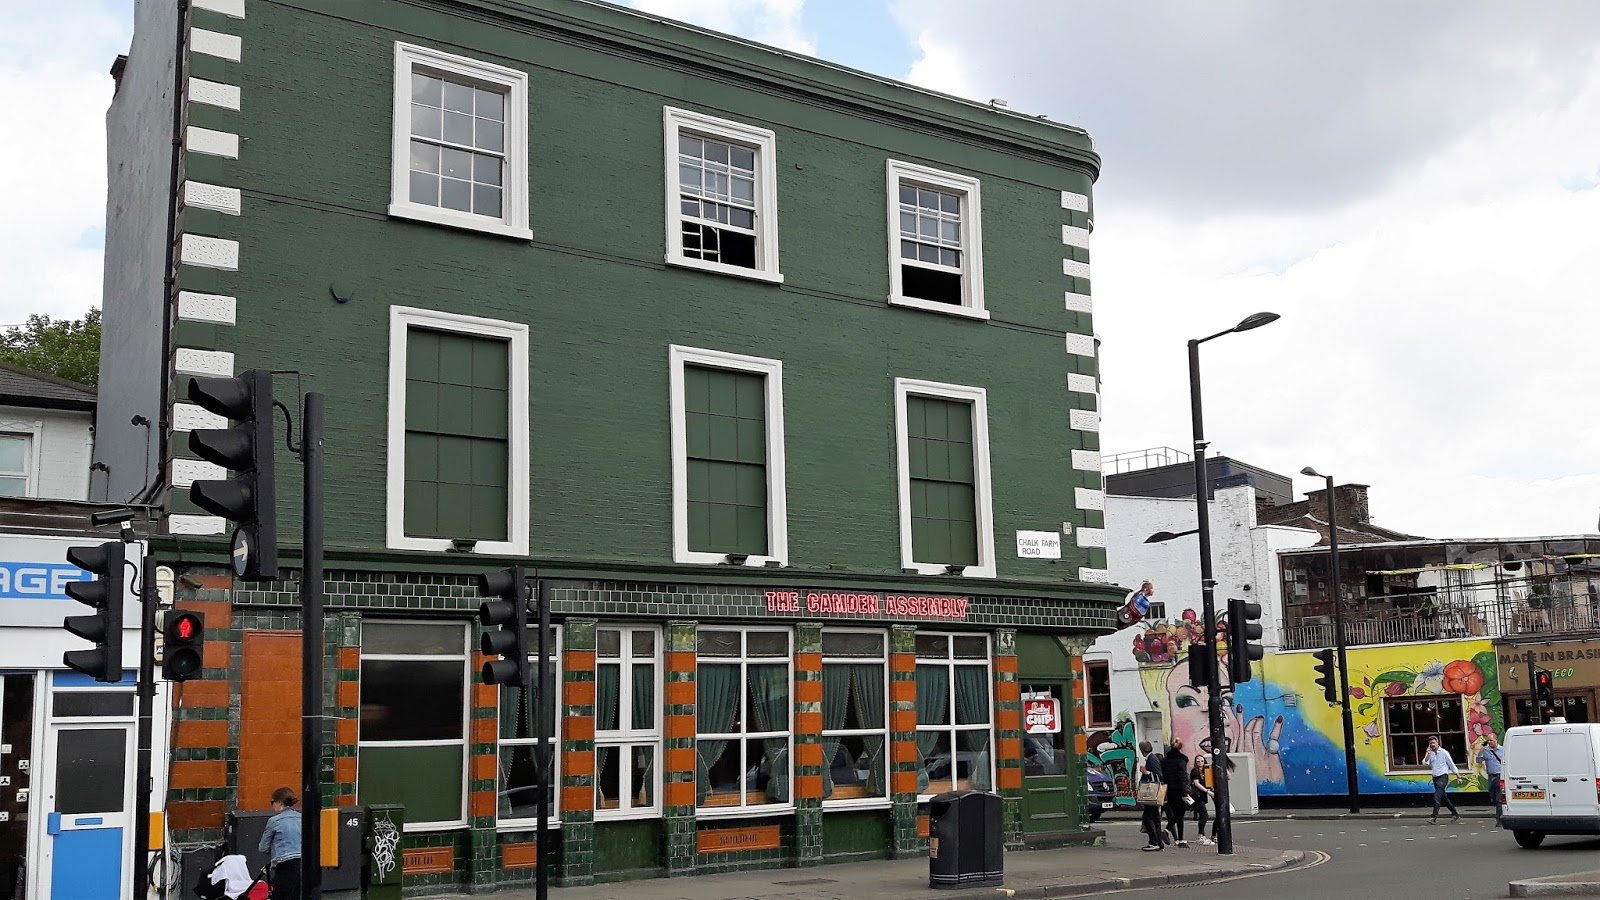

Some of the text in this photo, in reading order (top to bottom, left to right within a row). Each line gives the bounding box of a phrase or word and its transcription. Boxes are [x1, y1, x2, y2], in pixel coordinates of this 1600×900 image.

[1018, 538, 1059, 548] CHALK FARM
[1022, 547, 1041, 556] ROAD
[765, 591, 969, 618] THE CAMDEN ASSEMBLY
[1541, 651, 1555, 662] IN
[346, 817, 359, 827] 45
